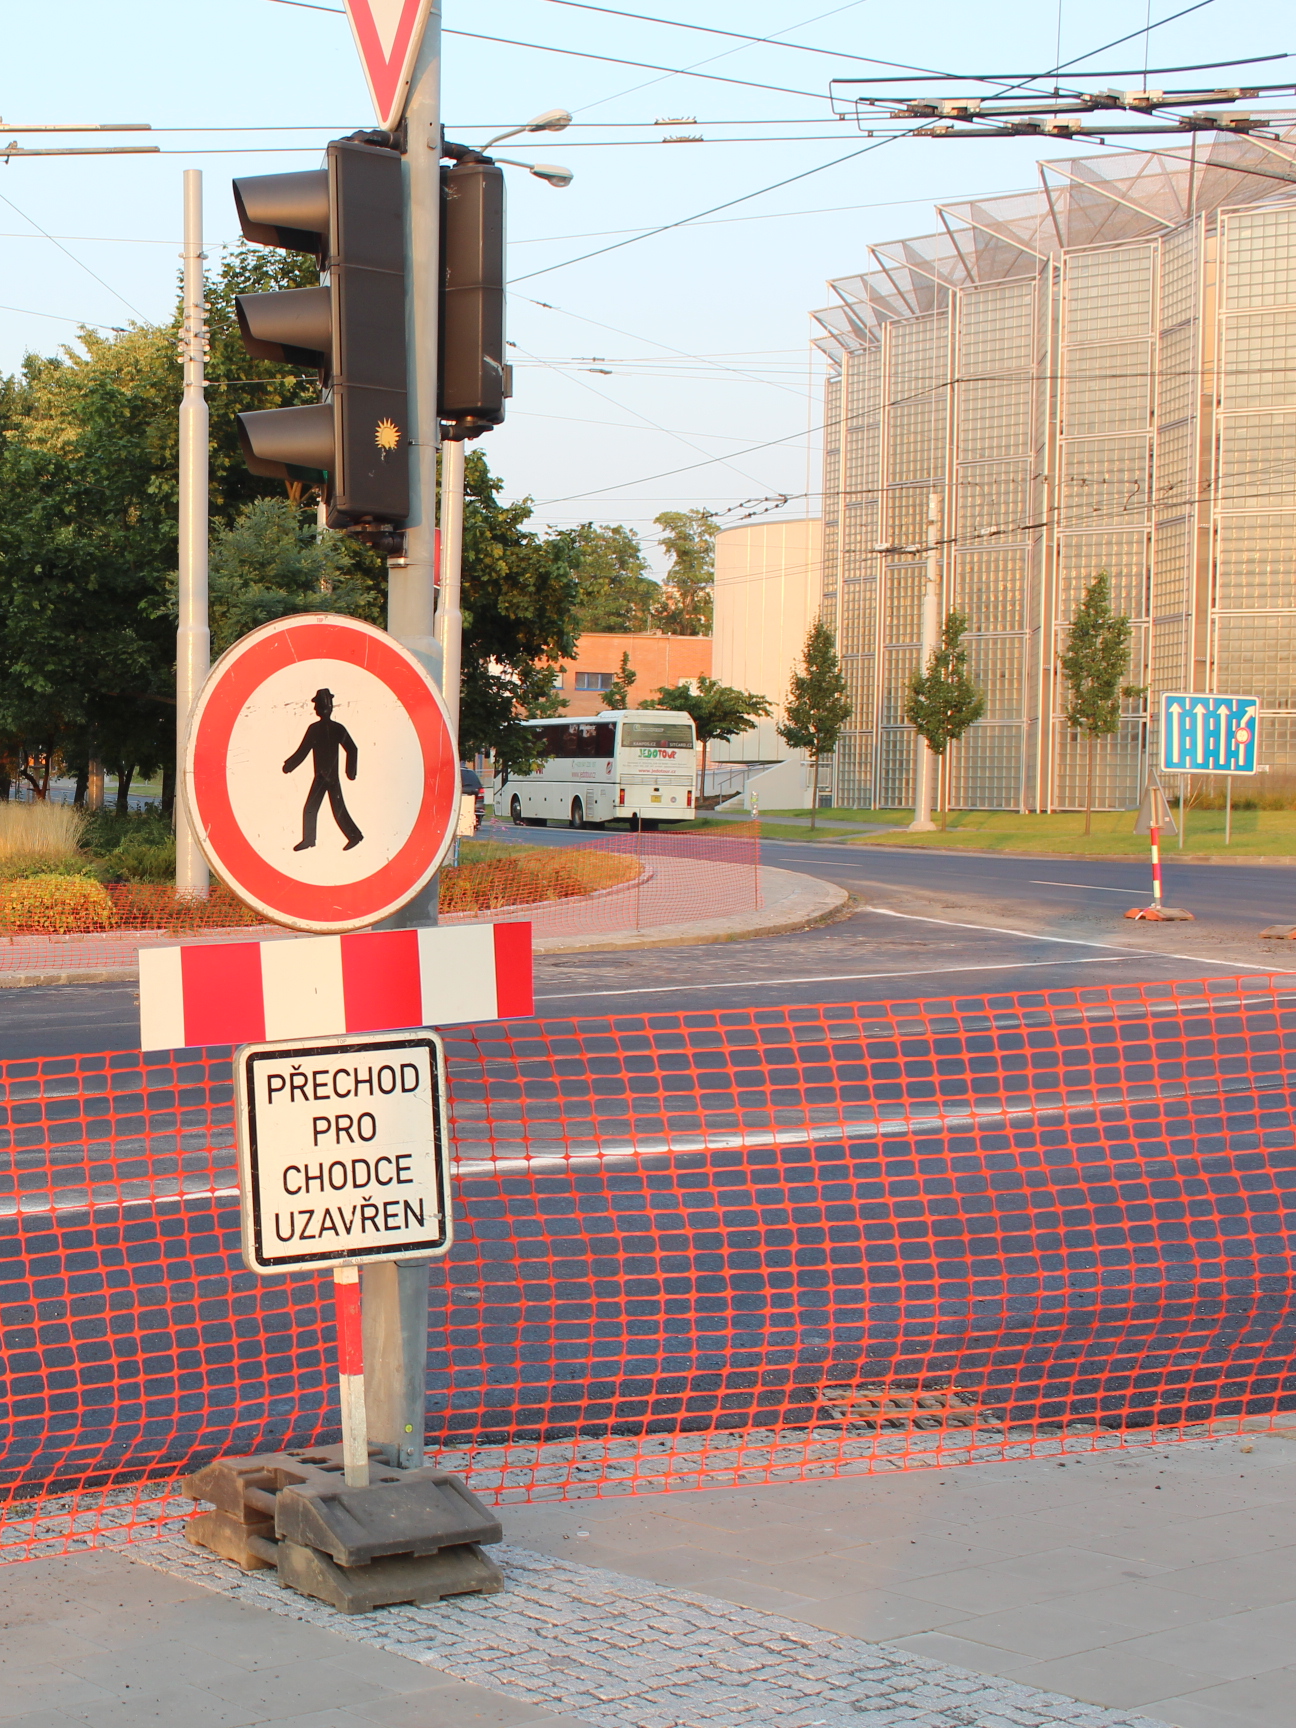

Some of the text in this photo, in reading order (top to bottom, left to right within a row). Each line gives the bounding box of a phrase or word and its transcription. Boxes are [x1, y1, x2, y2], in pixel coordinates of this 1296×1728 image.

[638, 749, 677, 759] JEDOTOUR
[267, 1063, 420, 1104] PŘECHOD
[313, 1112, 376, 1146] PRO
[283, 1154, 413, 1195] CHODCE
[275, 1196, 425, 1242] UZAVŘEN
